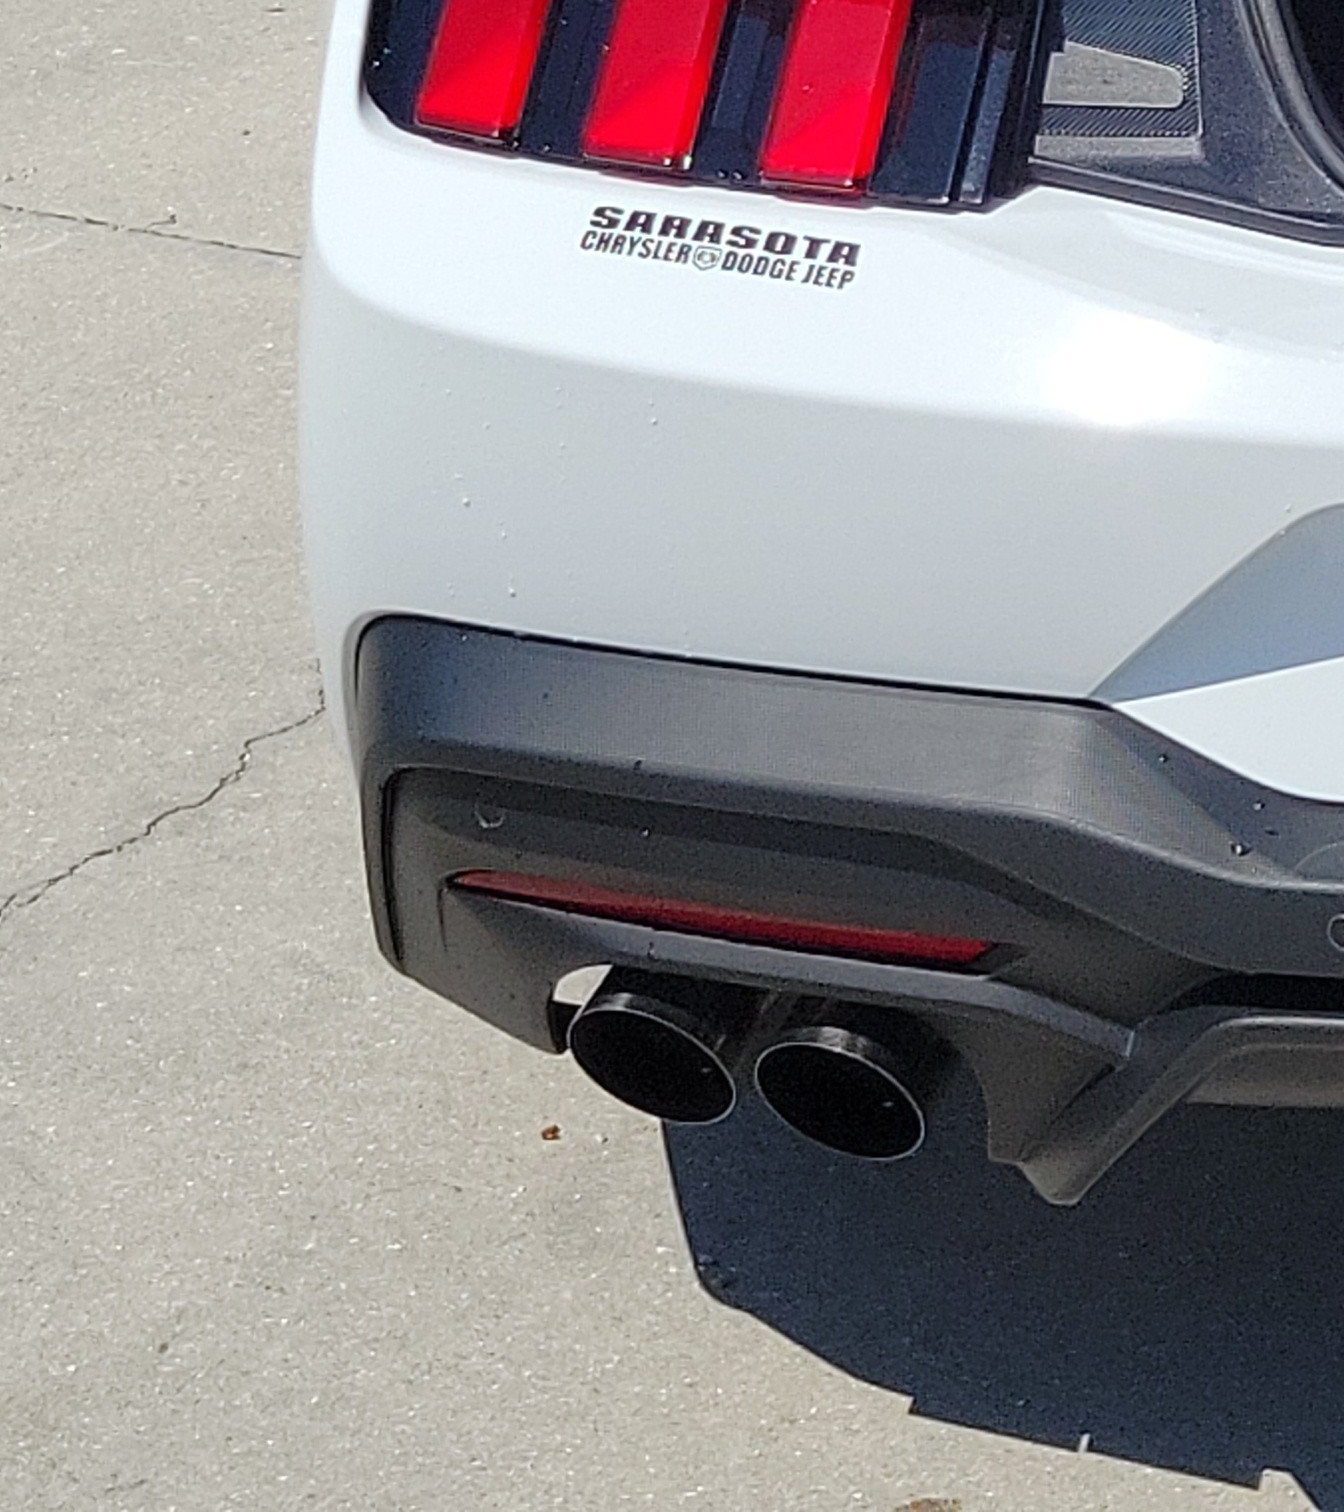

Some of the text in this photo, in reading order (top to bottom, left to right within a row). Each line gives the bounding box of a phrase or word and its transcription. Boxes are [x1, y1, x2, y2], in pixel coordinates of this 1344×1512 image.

[580, 229, 855, 290] CHRYSLER DODGE JEEP
[590, 206, 861, 267] SARASOTA
